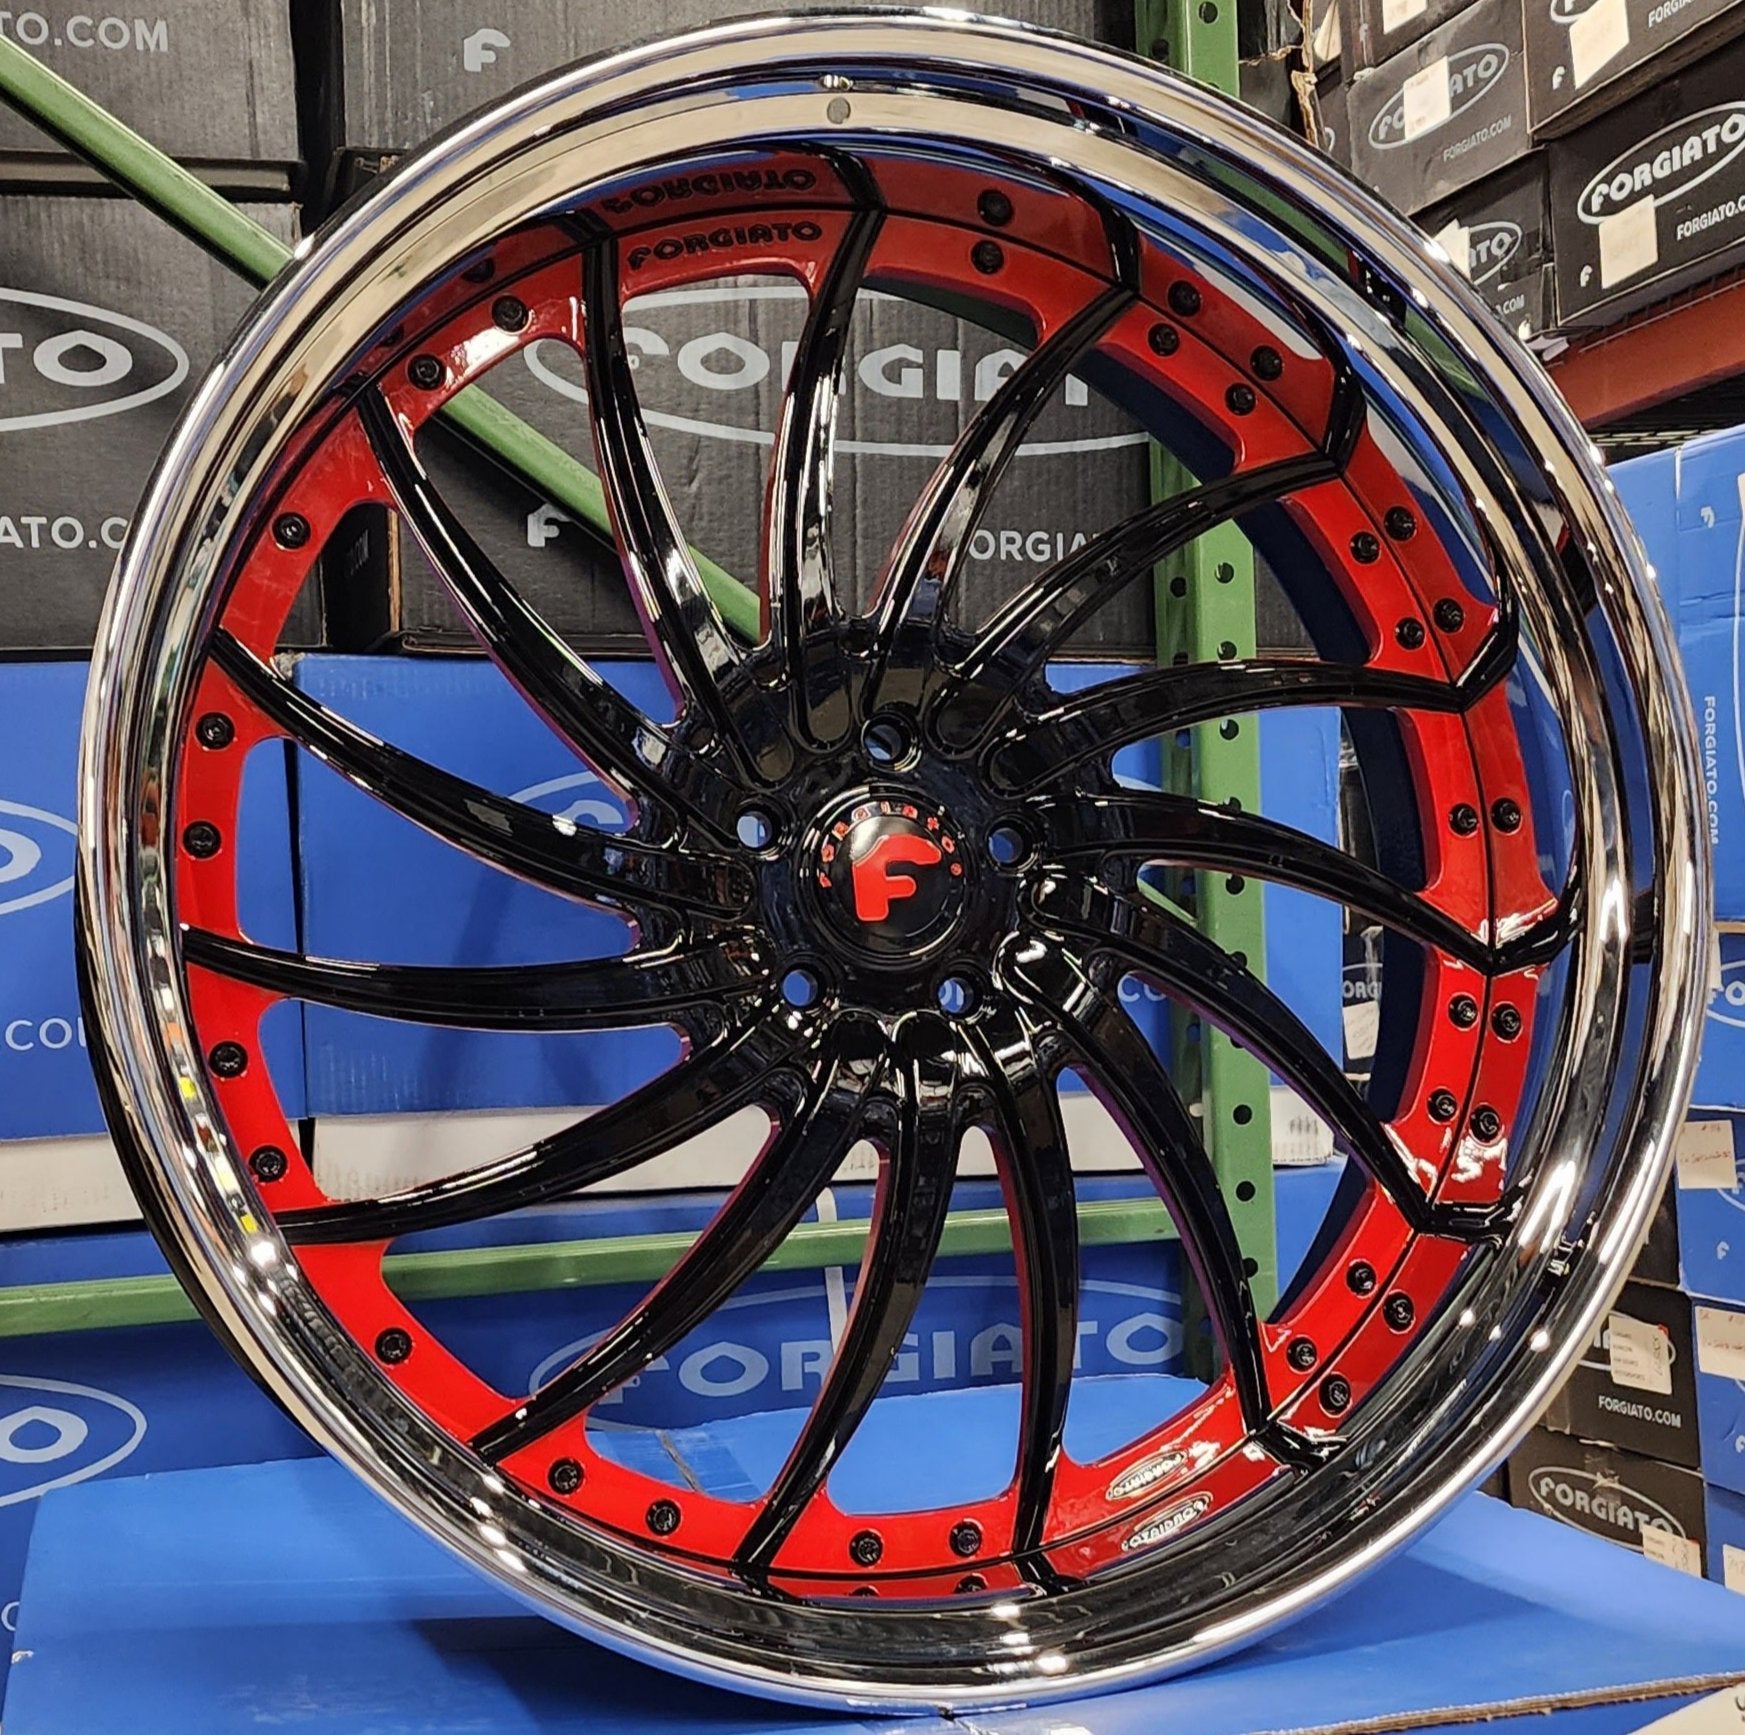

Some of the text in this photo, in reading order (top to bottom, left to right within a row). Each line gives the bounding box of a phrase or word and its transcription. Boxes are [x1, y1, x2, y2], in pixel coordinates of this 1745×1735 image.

[1378, 54, 1498, 140] FOATO
[1443, 115, 1512, 162] FORGIATO.COM
[1591, 113, 1745, 213] FORGIATO
[627, 221, 822, 271] FORGIATO
[969, 529, 1100, 562] ORGIA
[1704, 696, 1719, 845] FORGIATO.COM
[1598, 1395, 1682, 1428] FORGIATO.COM
